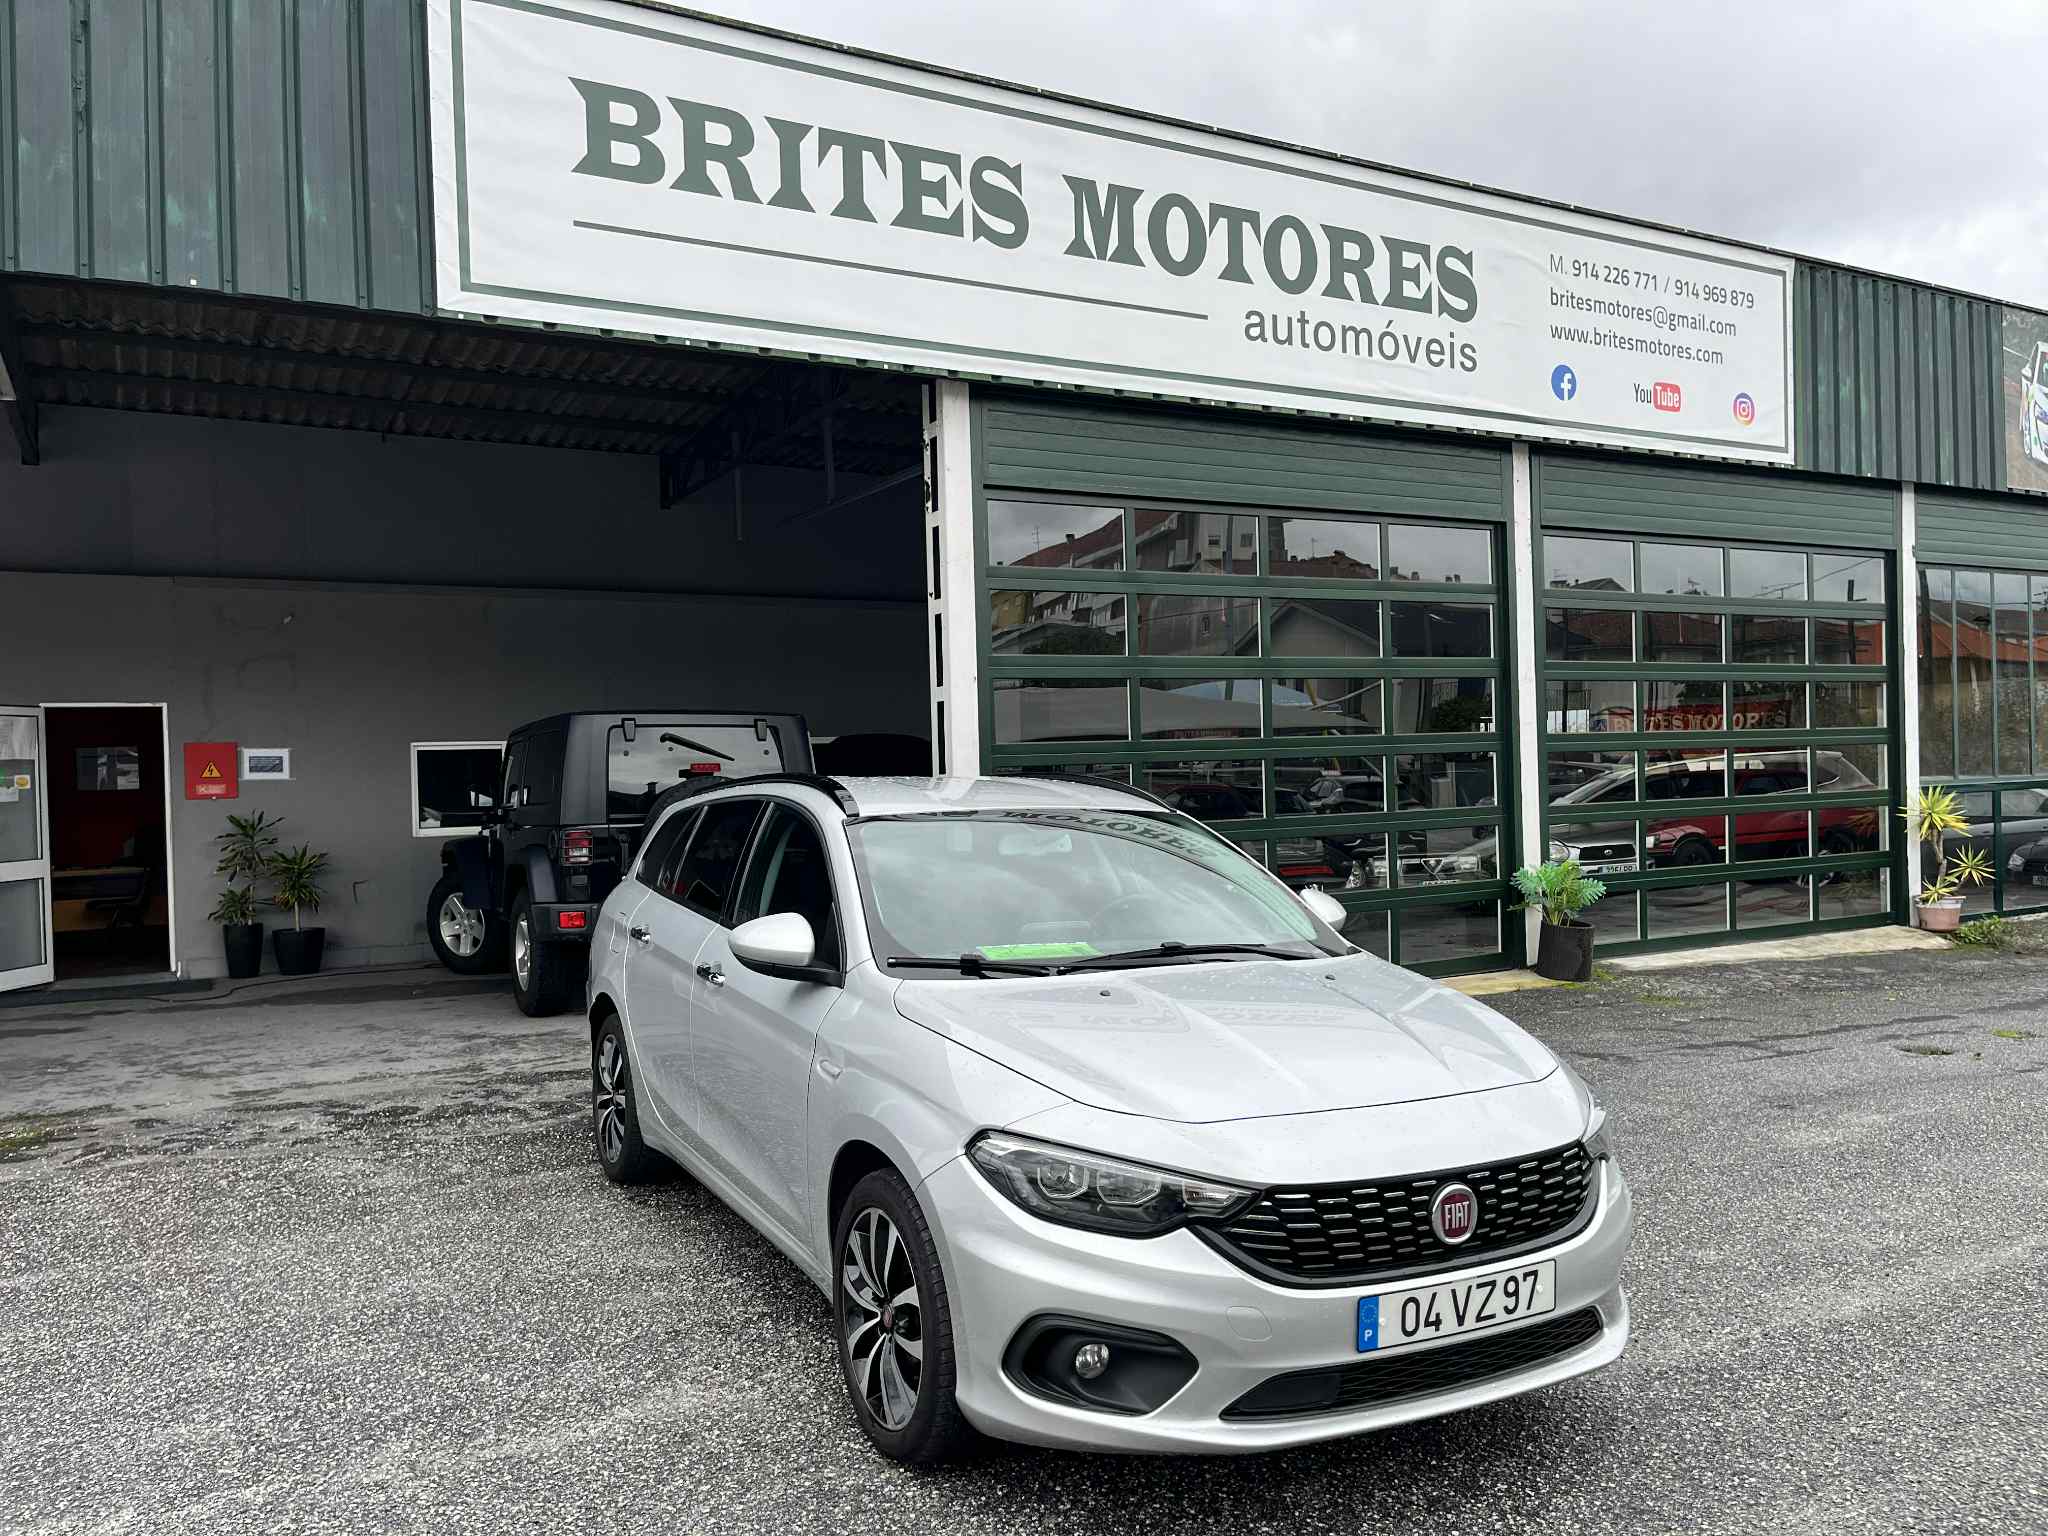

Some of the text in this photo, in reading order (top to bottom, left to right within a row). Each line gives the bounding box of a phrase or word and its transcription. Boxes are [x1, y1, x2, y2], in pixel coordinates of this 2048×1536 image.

[568, 76, 1478, 323] BRITES MOTORES
[1550, 253, 1754, 309] M. 914 226 771 / 914 969 879
[1550, 286, 1736, 336] britesmotores@gmail.com
[1244, 310, 1478, 372] automóveis
[1550, 324, 1723, 364] www.britesmotores.com
[1633, 383, 1680, 408] YouTube
[1614, 710, 1787, 731] BTES MOORES
[1443, 1201, 1470, 1229] FIAT
[1401, 1269, 1539, 1337] 04 VZ 97
[1364, 1329, 1372, 1341] P
